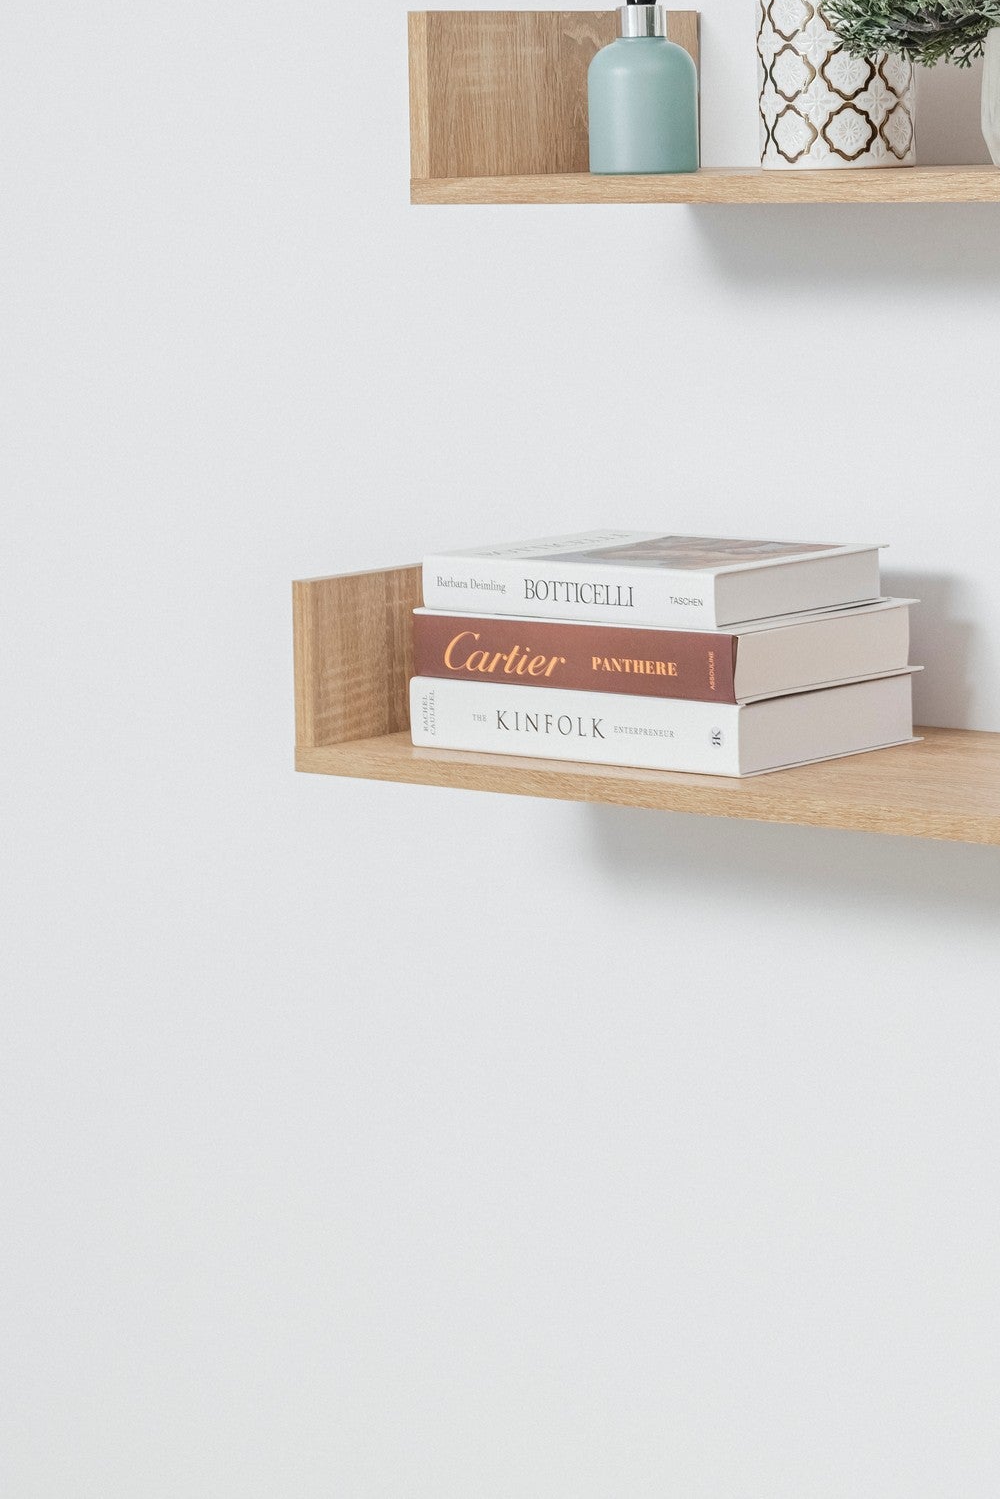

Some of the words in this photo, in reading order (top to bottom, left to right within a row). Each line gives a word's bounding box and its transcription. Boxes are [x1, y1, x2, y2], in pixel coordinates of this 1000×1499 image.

[436, 576, 468, 589] Barbara
[470, 579, 506, 594] Deimling
[523, 578, 635, 608] BOTTICELLI
[669, 596, 704, 607] TASCHEN
[443, 630, 566, 678] Cartier
[591, 656, 678, 677] PANTHERE
[707, 651, 715, 691] ASSOULINE
[472, 713, 488, 723] THE
[496, 709, 606, 739] KINFOLK
